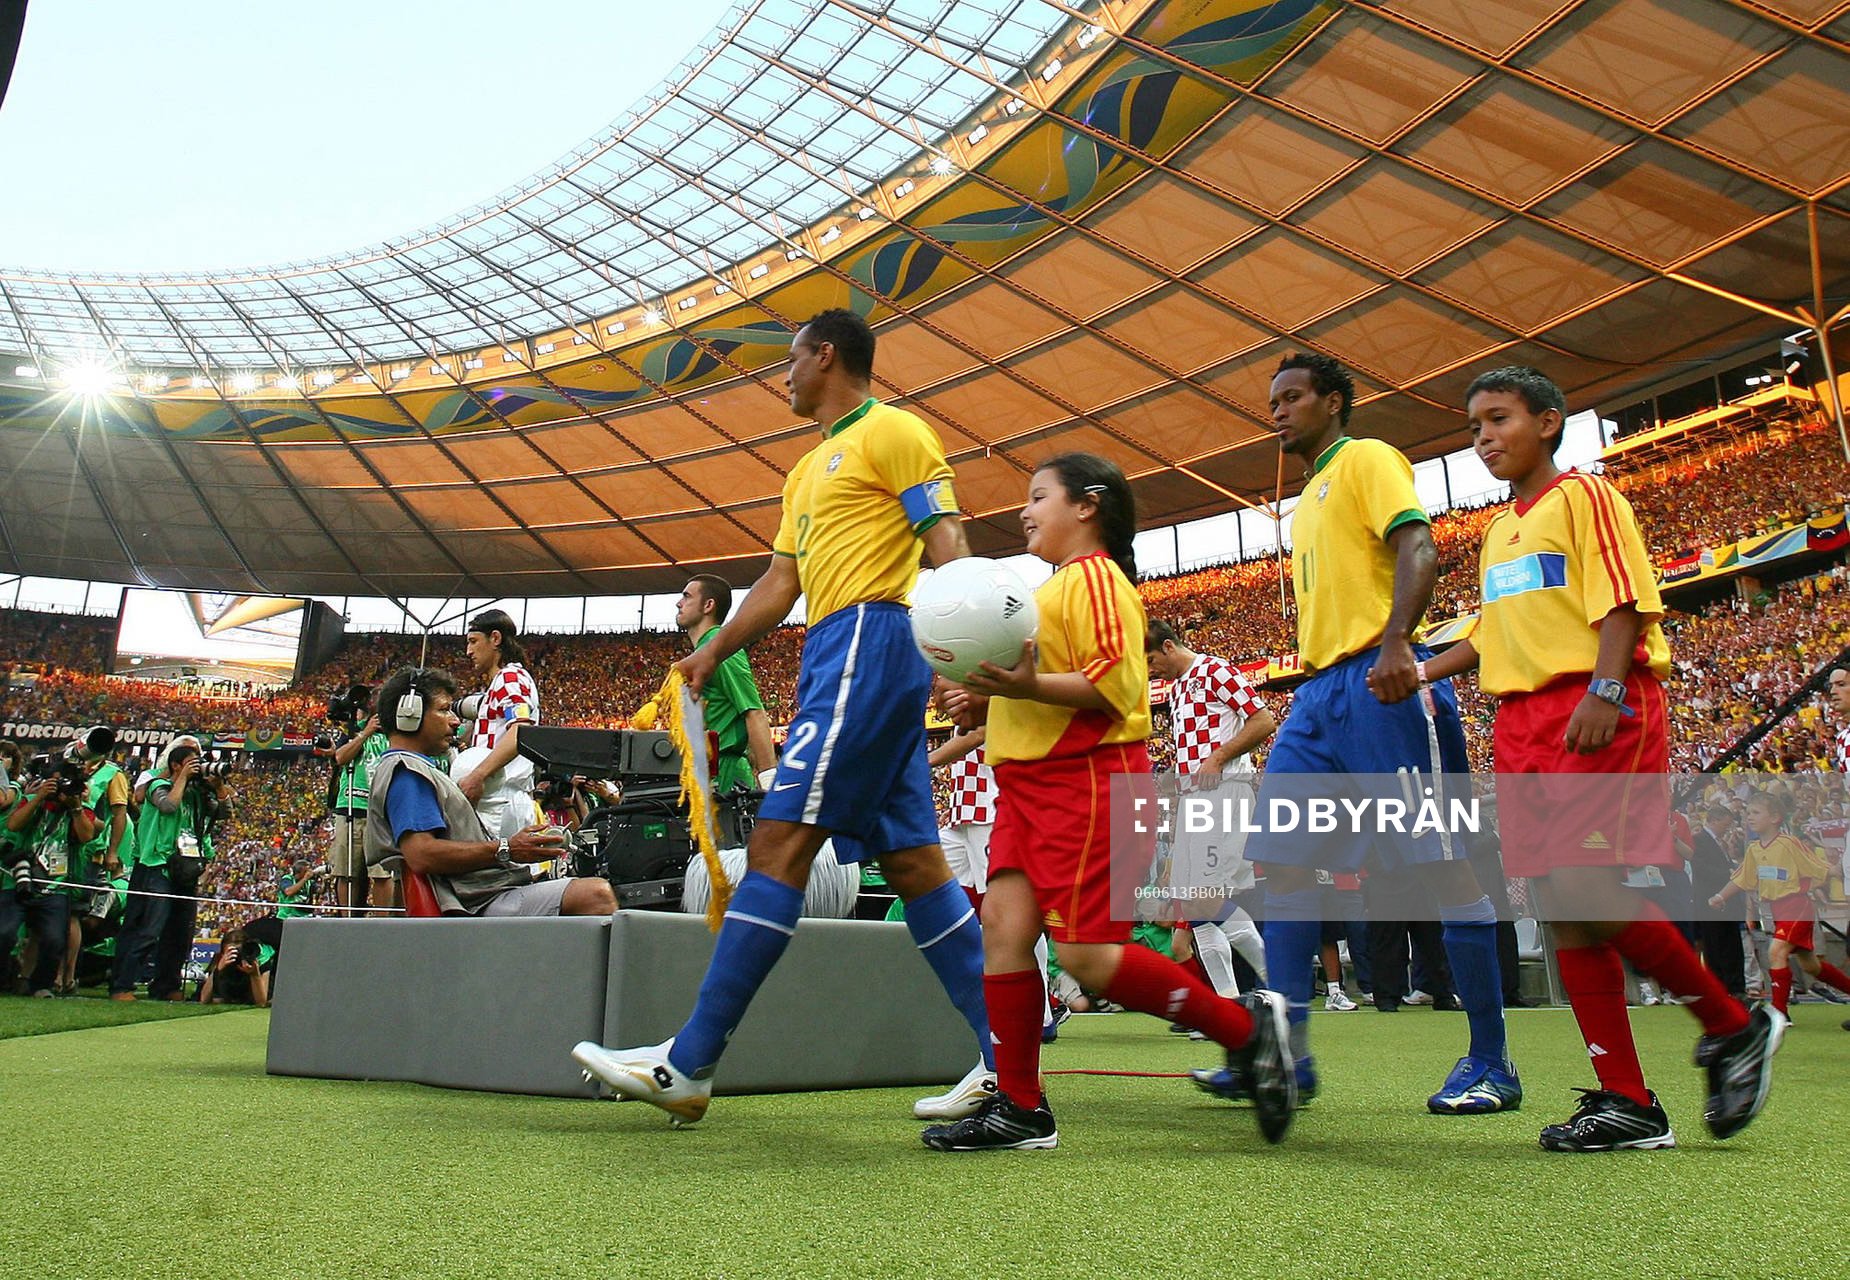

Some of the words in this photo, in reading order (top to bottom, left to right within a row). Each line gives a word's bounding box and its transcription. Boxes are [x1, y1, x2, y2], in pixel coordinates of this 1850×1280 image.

[797, 513, 810, 557] 2
[114, 729, 175, 744] JOVEM
[783, 720, 819, 770] 2
[1205, 845, 1219, 868] 5
